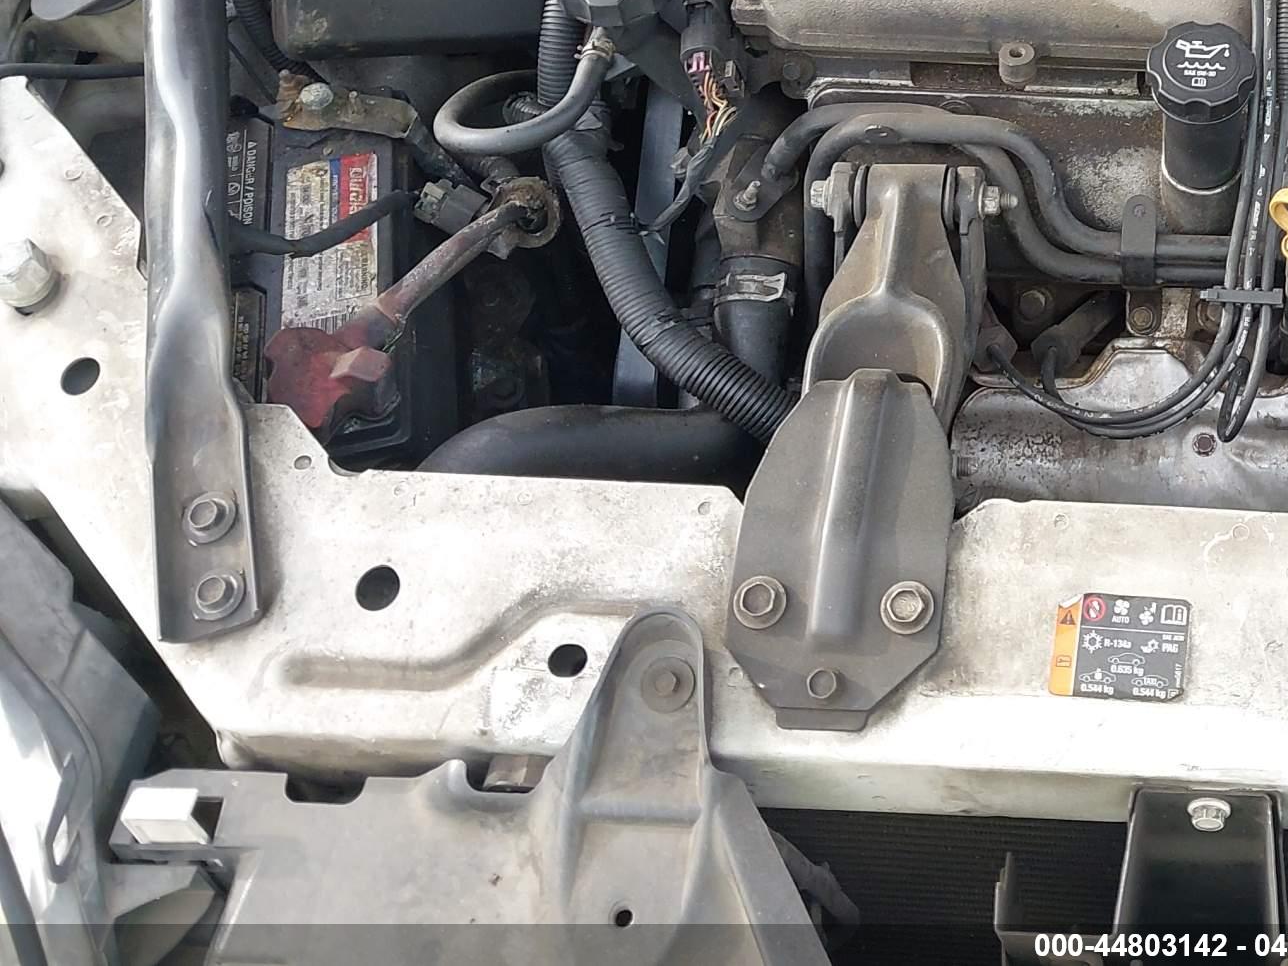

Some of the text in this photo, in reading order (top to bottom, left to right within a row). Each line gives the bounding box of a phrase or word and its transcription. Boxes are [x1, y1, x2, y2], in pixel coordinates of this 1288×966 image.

[242, 193, 255, 225] POISON
[1111, 615, 1130, 624] AUTO
[1103, 638, 1132, 649] R-134a
[1162, 642, 1179, 653] PAG
[1133, 666, 1144, 677] kg
[1103, 685, 1114, 695] kg
[1155, 689, 1167, 700] kg
